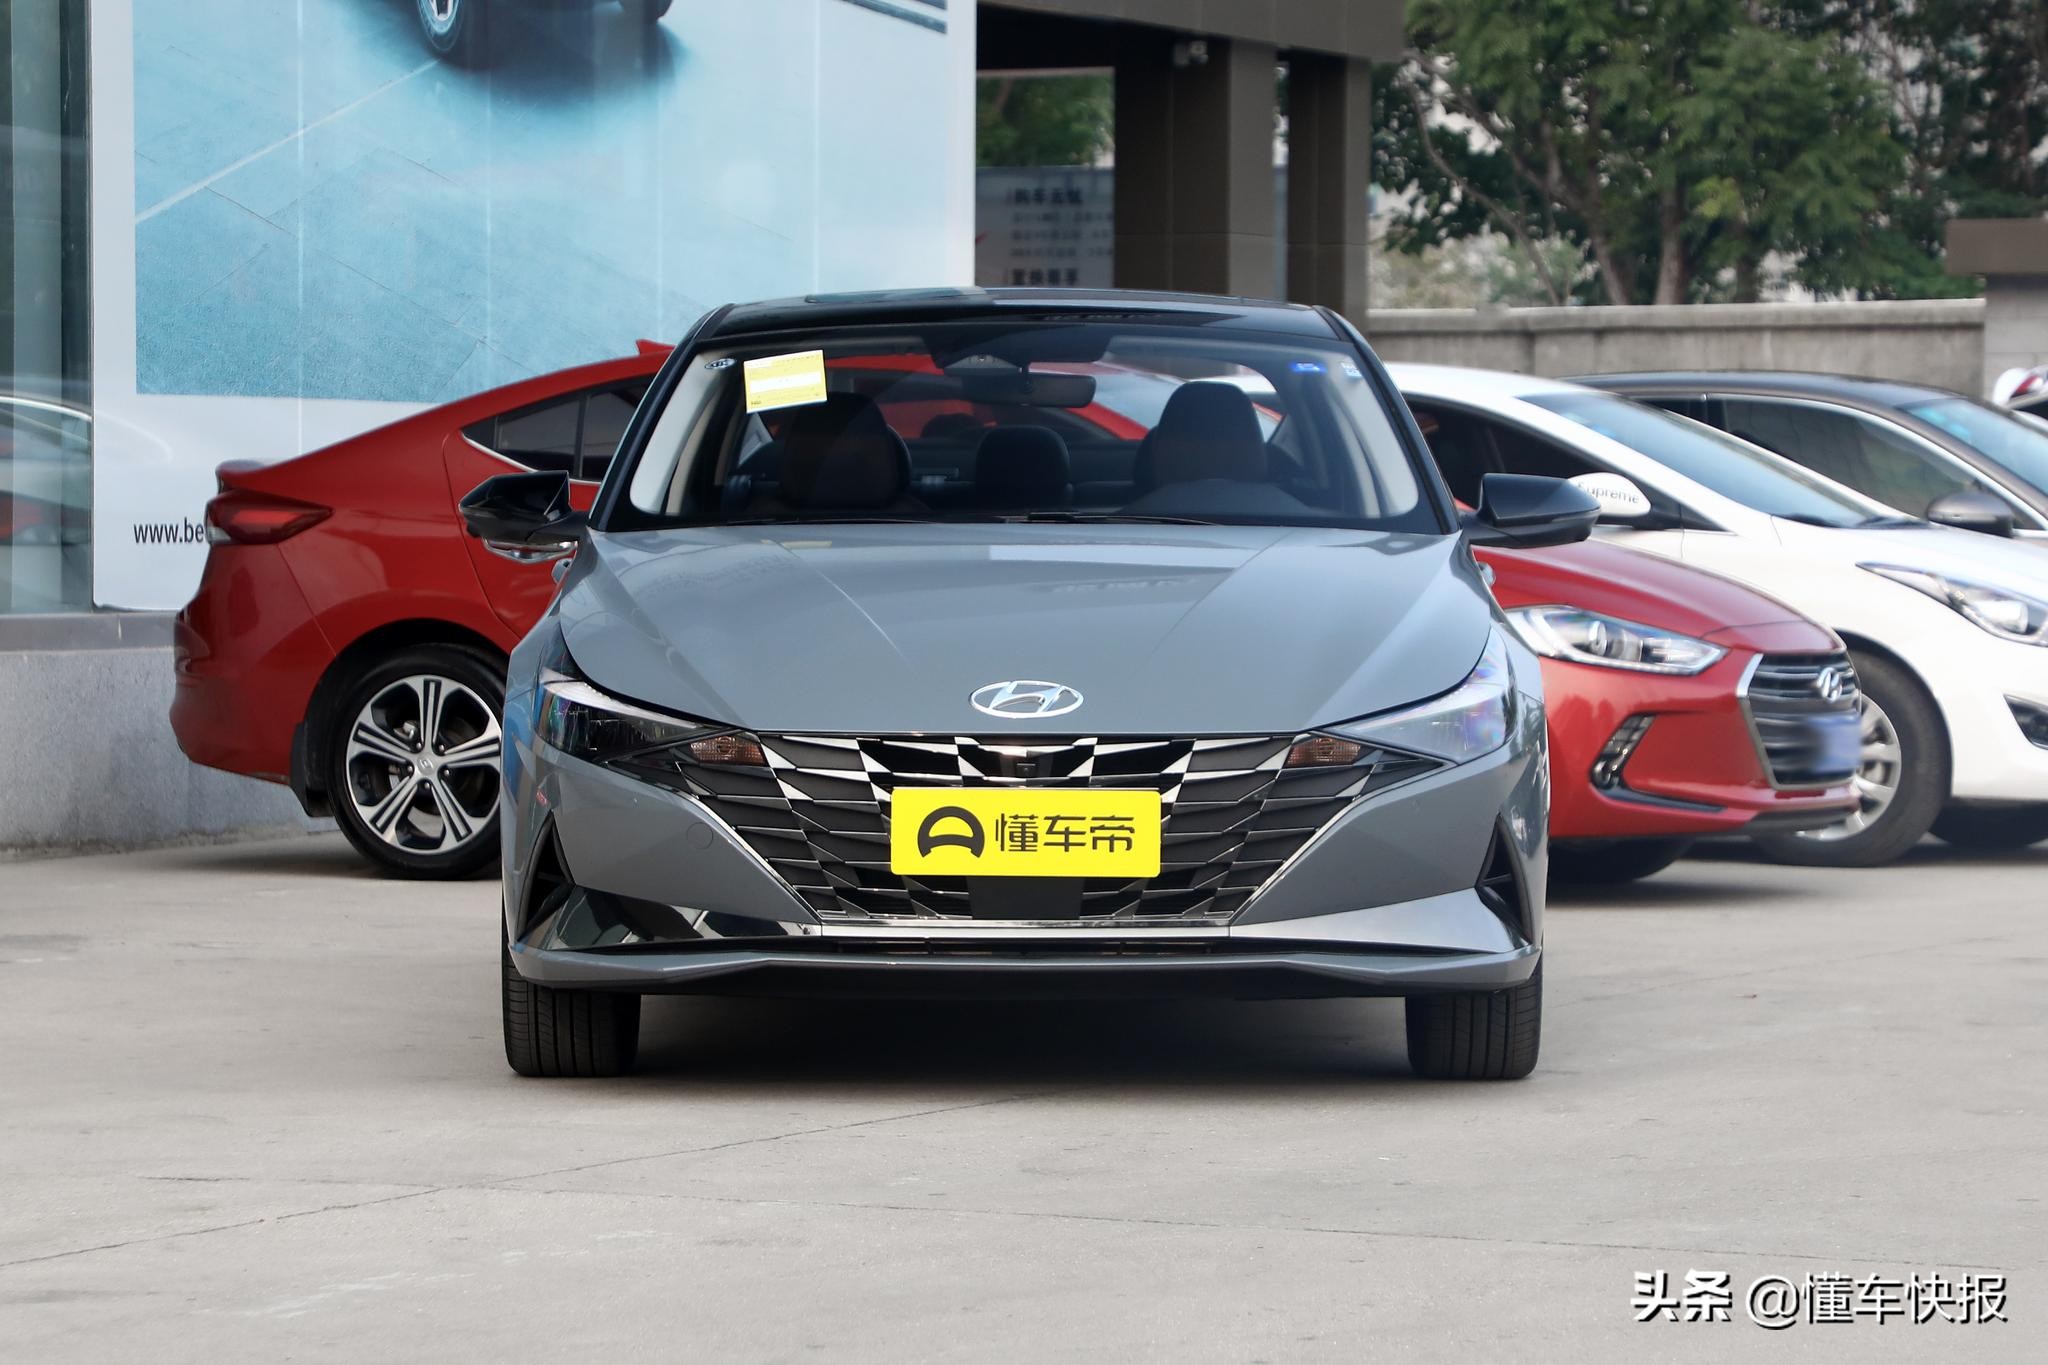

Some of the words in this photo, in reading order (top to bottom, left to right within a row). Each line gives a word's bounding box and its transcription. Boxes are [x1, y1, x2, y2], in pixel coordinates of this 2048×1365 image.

[133, 516, 204, 544] www.be
[995, 812, 1136, 853] 懂车帝
